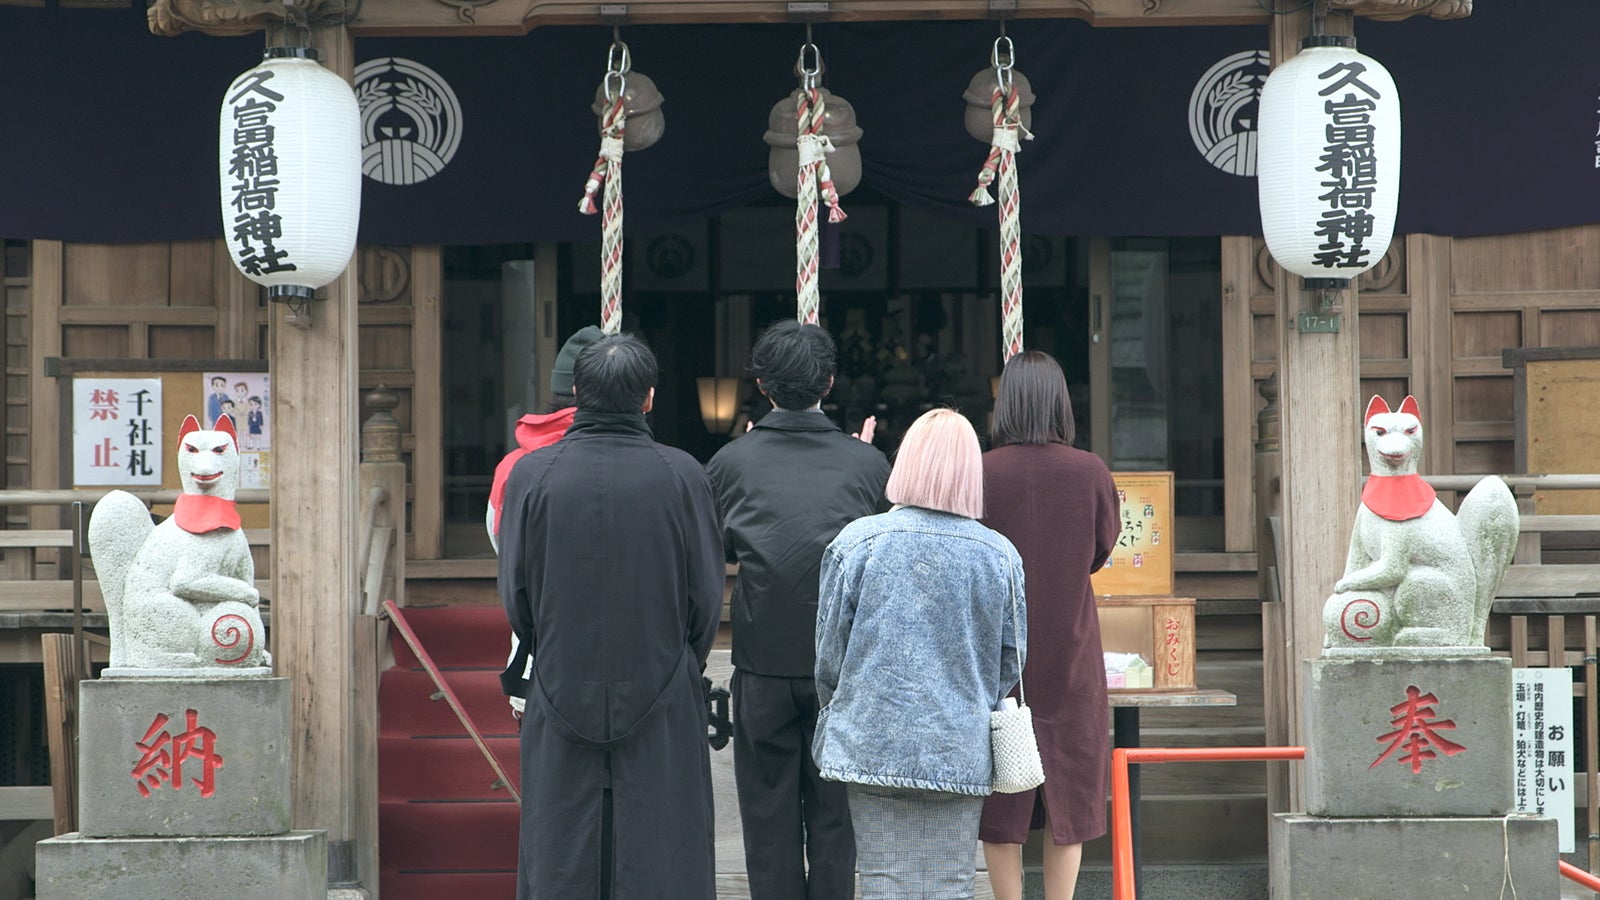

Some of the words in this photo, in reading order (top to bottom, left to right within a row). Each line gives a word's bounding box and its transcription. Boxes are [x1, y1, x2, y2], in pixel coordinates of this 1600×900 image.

[228, 70, 297, 276] 久富稲荷神社
[1311, 61, 1381, 268] 久富稲荷神社
[1305, 316, 1334, 328] 17-1
[89, 389, 120, 468] 禁止
[126, 389, 153, 476] 千社札
[1116, 535, 1140, 547] くじ
[1120, 520, 1143, 532] ろう
[1166, 618, 1180, 676] おみくじ
[130, 708, 223, 798] 納
[1368, 685, 1467, 774] 奉
[1548, 725, 1565, 792] お願い
